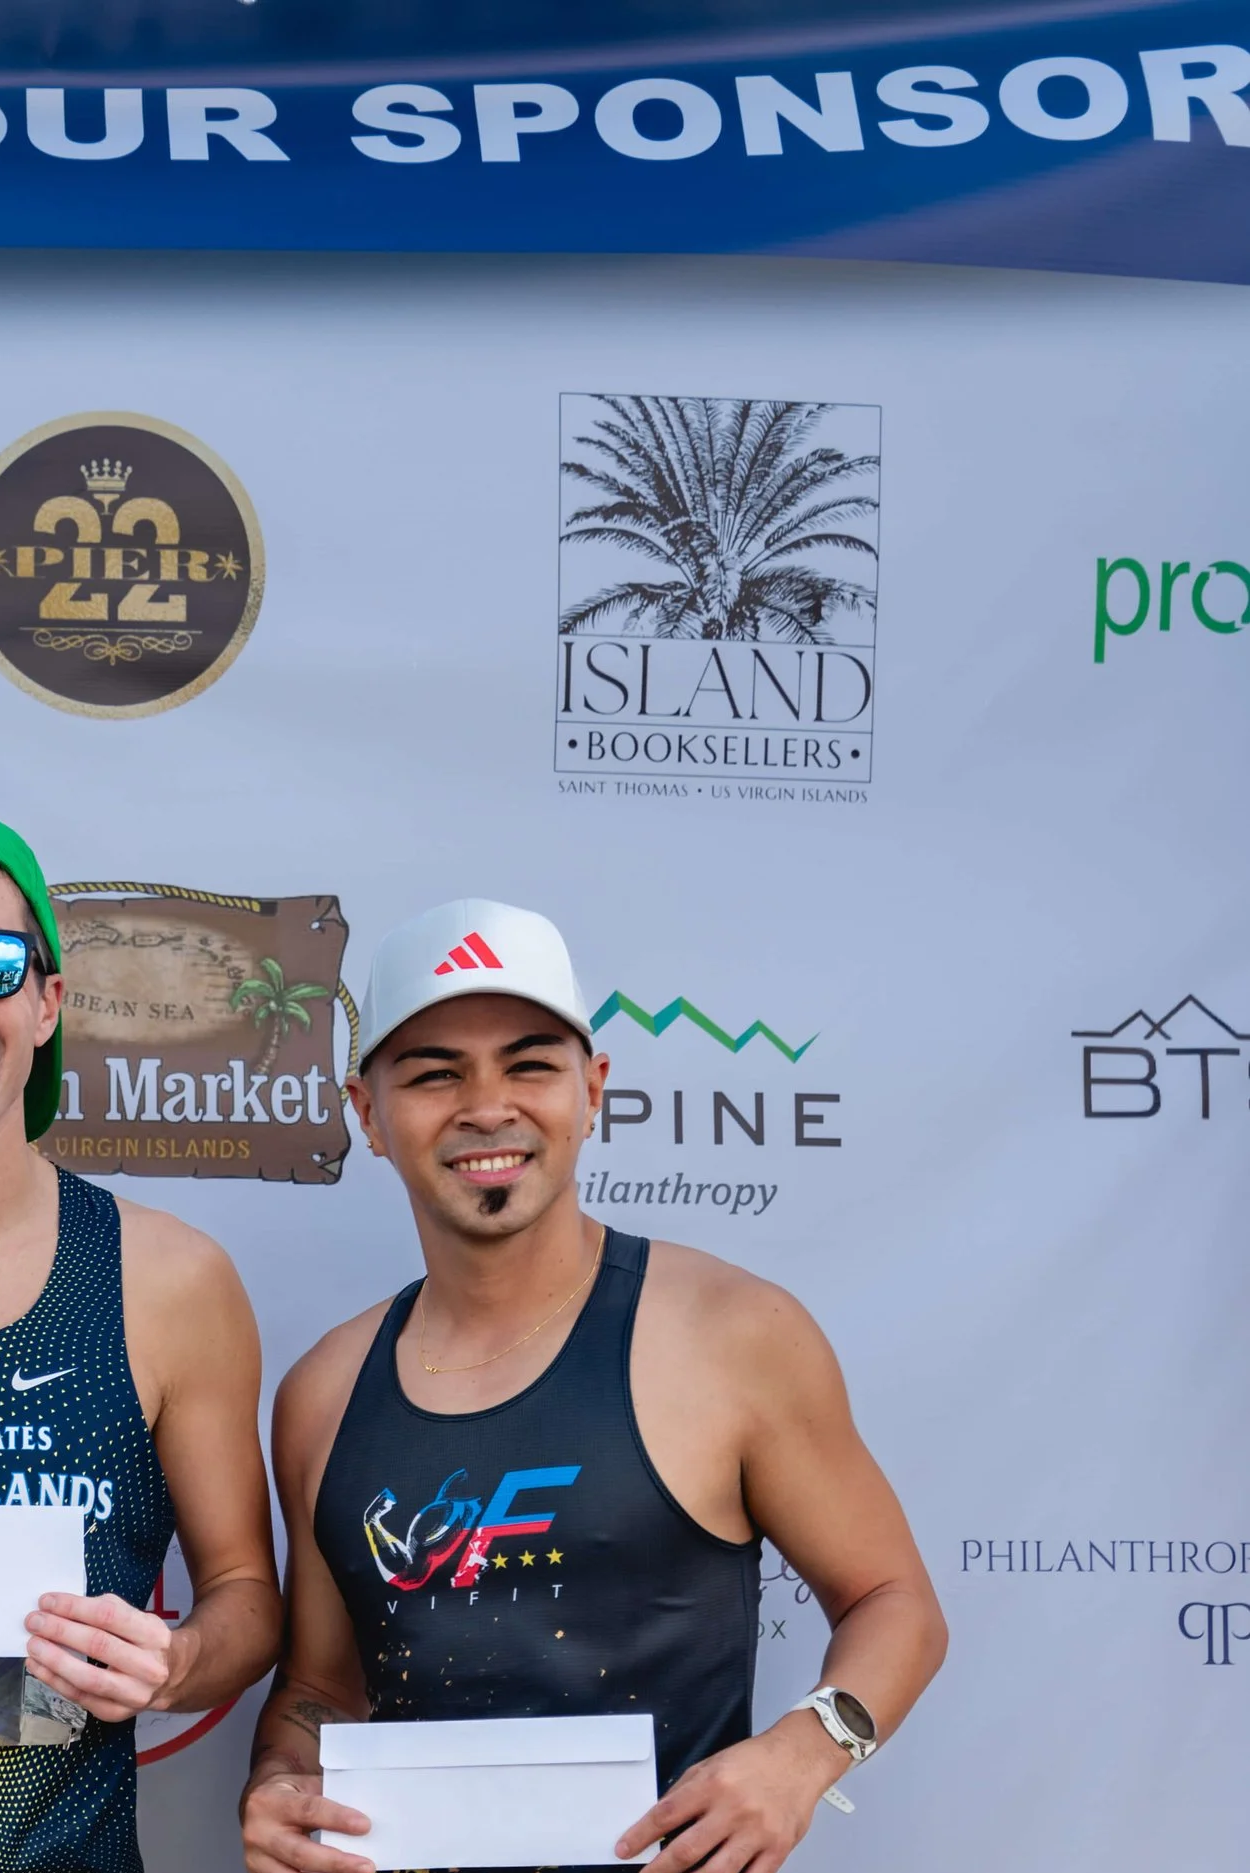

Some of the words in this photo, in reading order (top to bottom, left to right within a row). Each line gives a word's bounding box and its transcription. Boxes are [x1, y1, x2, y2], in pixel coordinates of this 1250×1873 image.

[12, 545, 217, 582] PIER
[561, 641, 871, 723] ISLAND
[587, 730, 841, 769] BOOKSELLERS
[558, 780, 607, 794] SAINT
[614, 781, 689, 797] THOMAS
[711, 785, 731, 799] US
[738, 786, 795, 801] VIRGIN
[801, 788, 868, 803] ISLANDS
[148, 1004, 196, 1021] SEA
[104, 1056, 330, 1125] Market
[56, 1136, 140, 1158] VIRGIN
[146, 1137, 251, 1160] ISLANDS
[577, 1170, 778, 1216] ilanthropy
